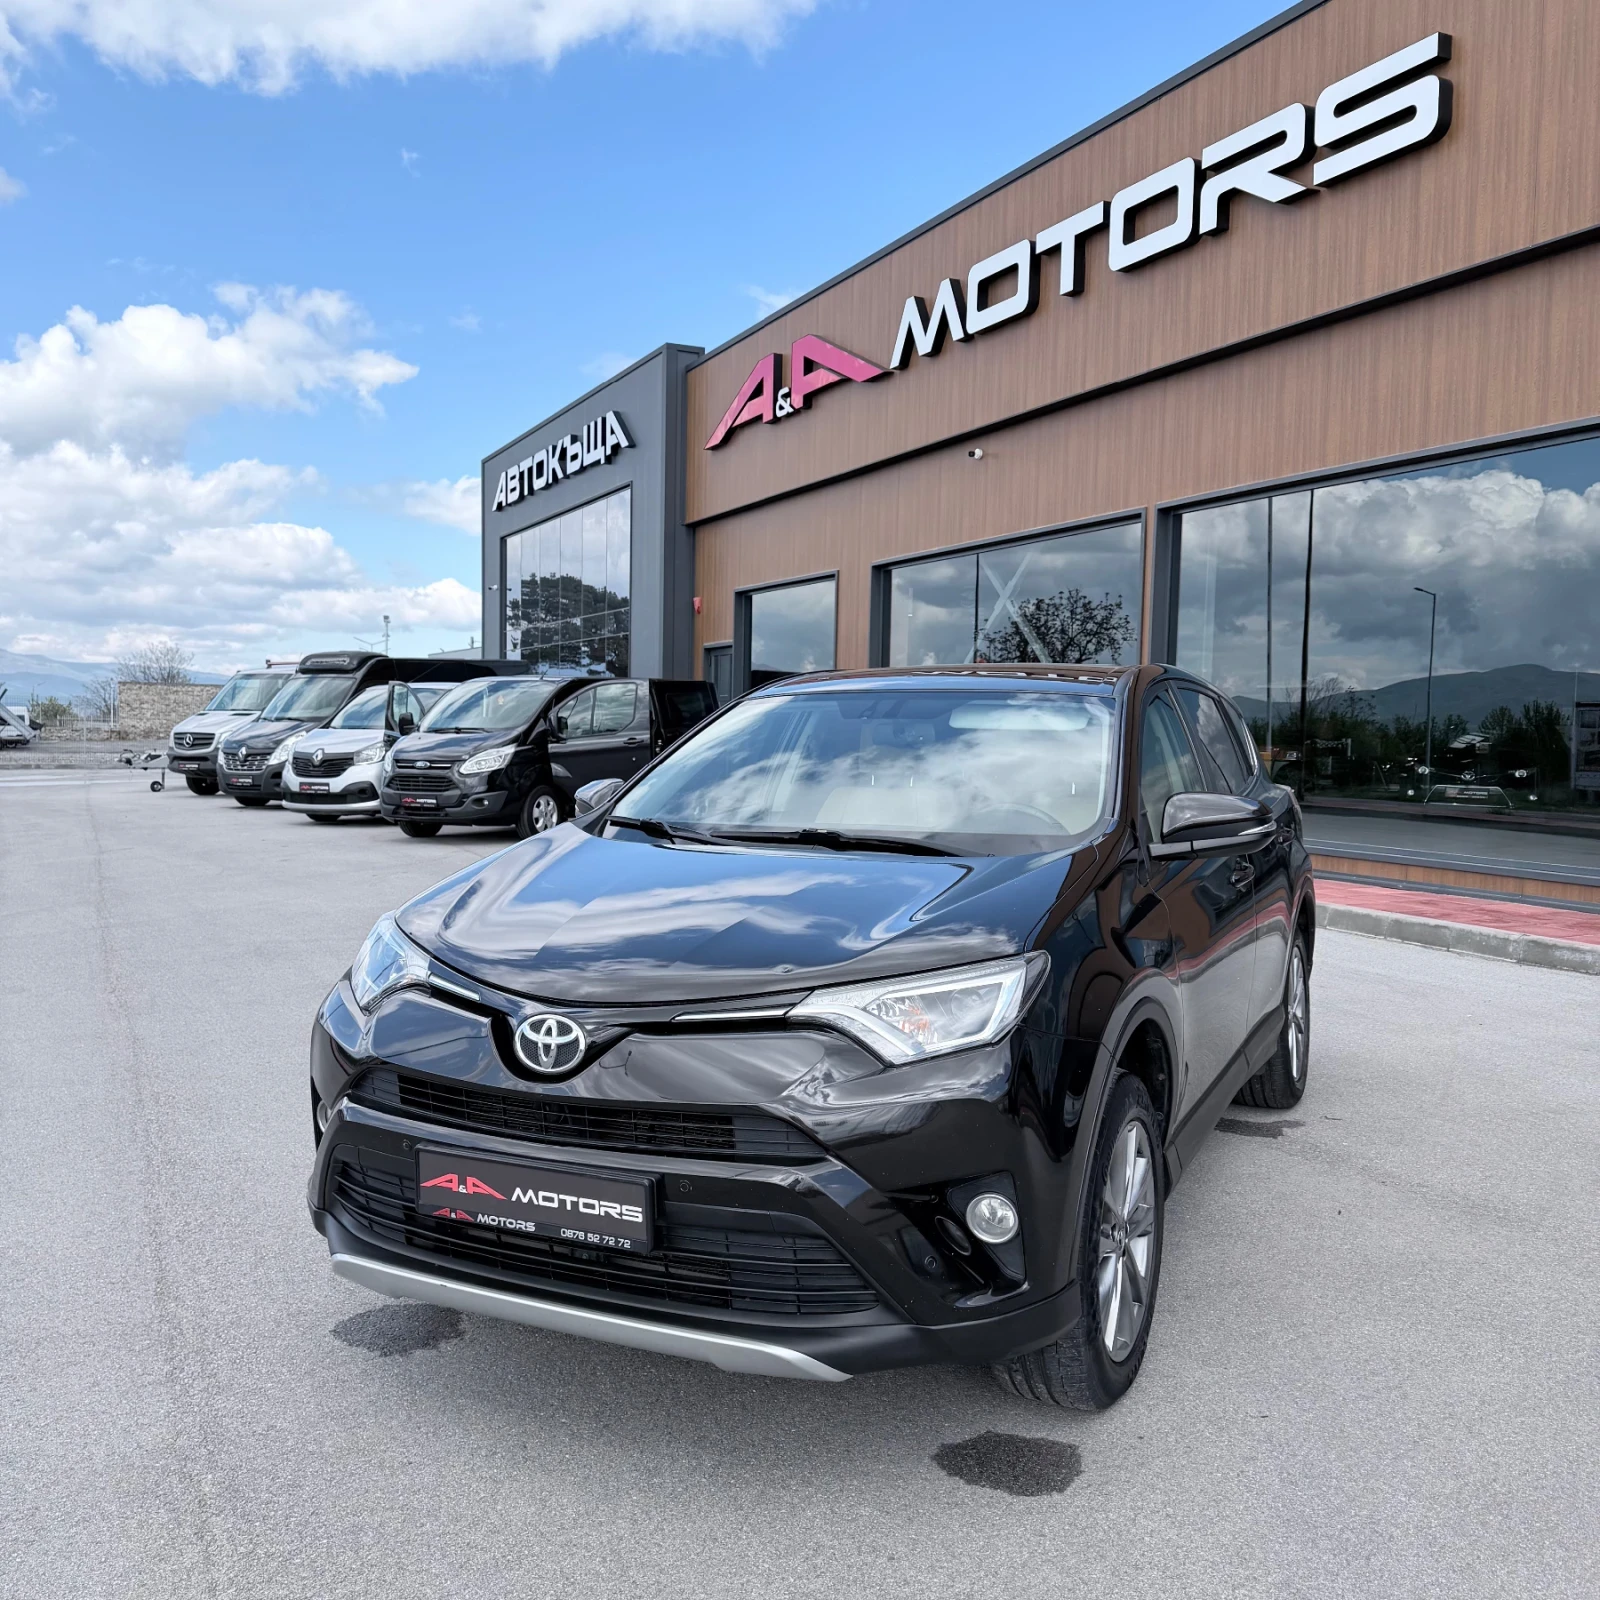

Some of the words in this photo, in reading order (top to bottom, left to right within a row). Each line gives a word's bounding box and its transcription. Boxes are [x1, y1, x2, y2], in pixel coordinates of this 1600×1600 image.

[704, 334, 890, 450] A&A
[889, 32, 1450, 370] MOTORS
[492, 410, 633, 512] АВТОКЪЩА
[420, 1173, 508, 1201] A&A
[511, 1187, 643, 1223] MOTORS
[477, 1213, 536, 1232] MOTORS
[587, 1232, 601, 1244] 52
[602, 1235, 616, 1246] 72
[617, 1238, 631, 1249] 72
